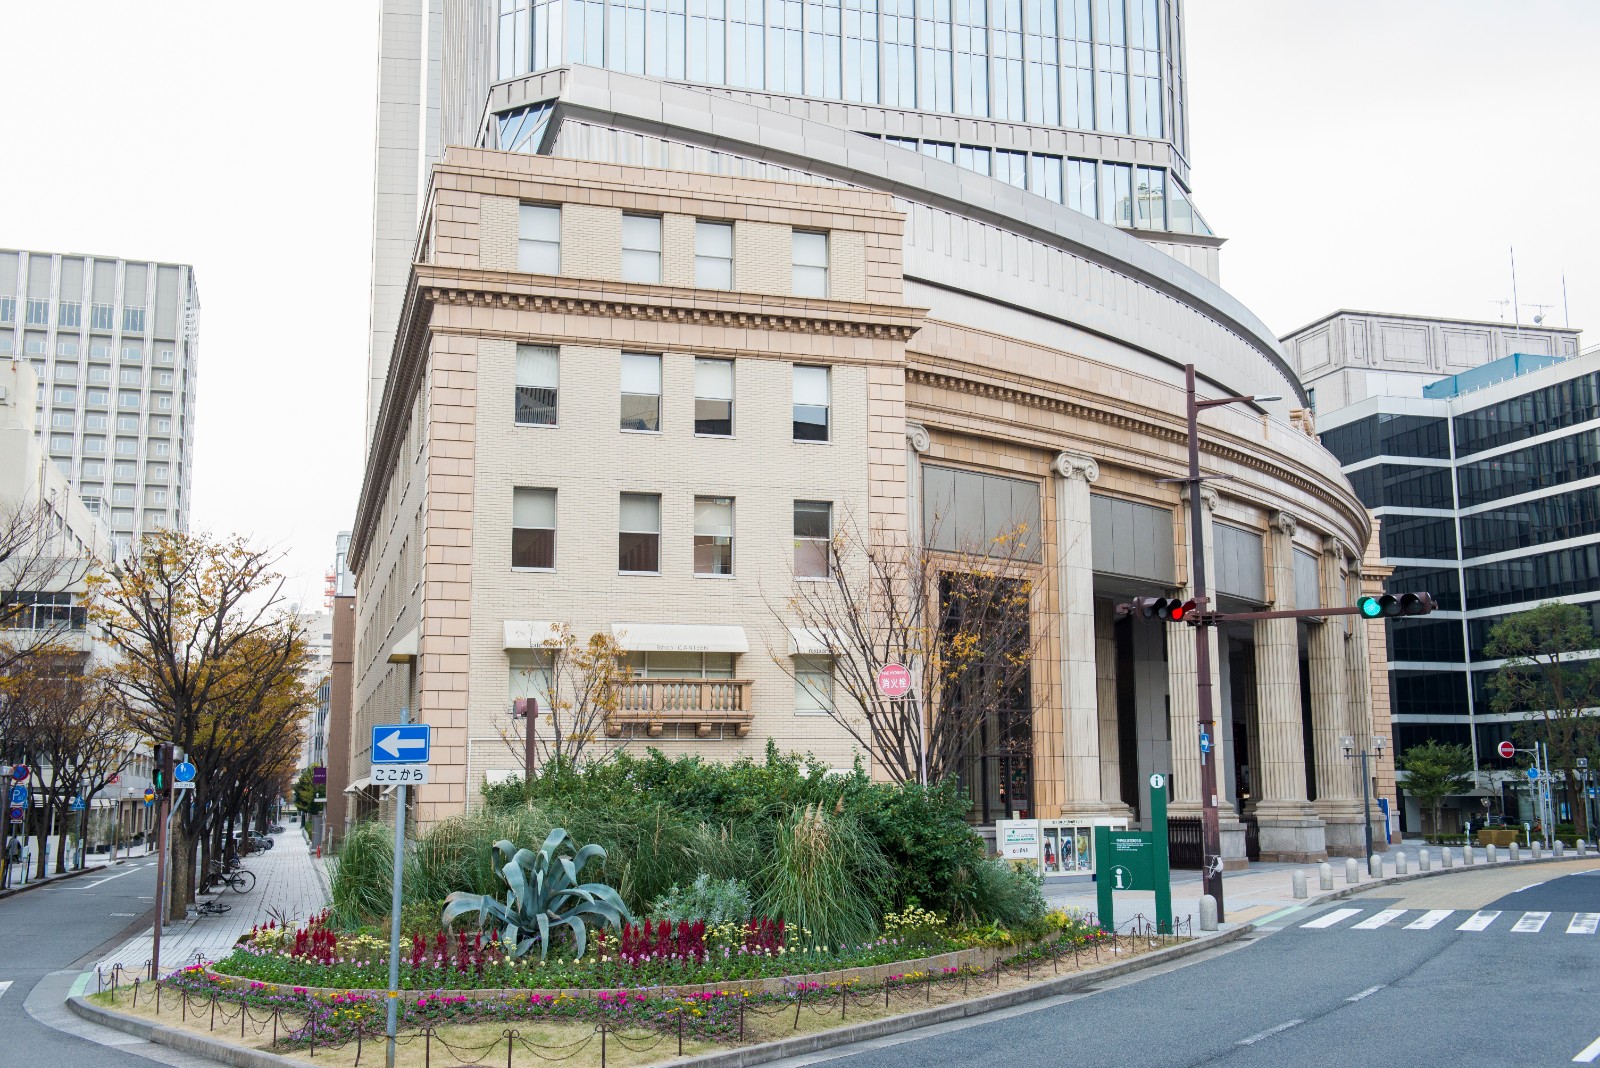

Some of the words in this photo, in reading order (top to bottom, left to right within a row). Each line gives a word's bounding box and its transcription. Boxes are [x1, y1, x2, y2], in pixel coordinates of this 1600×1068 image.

[882, 678, 907, 689] 消火栓
[375, 768, 423, 781] ここから
[12, 789, 21, 801] P
